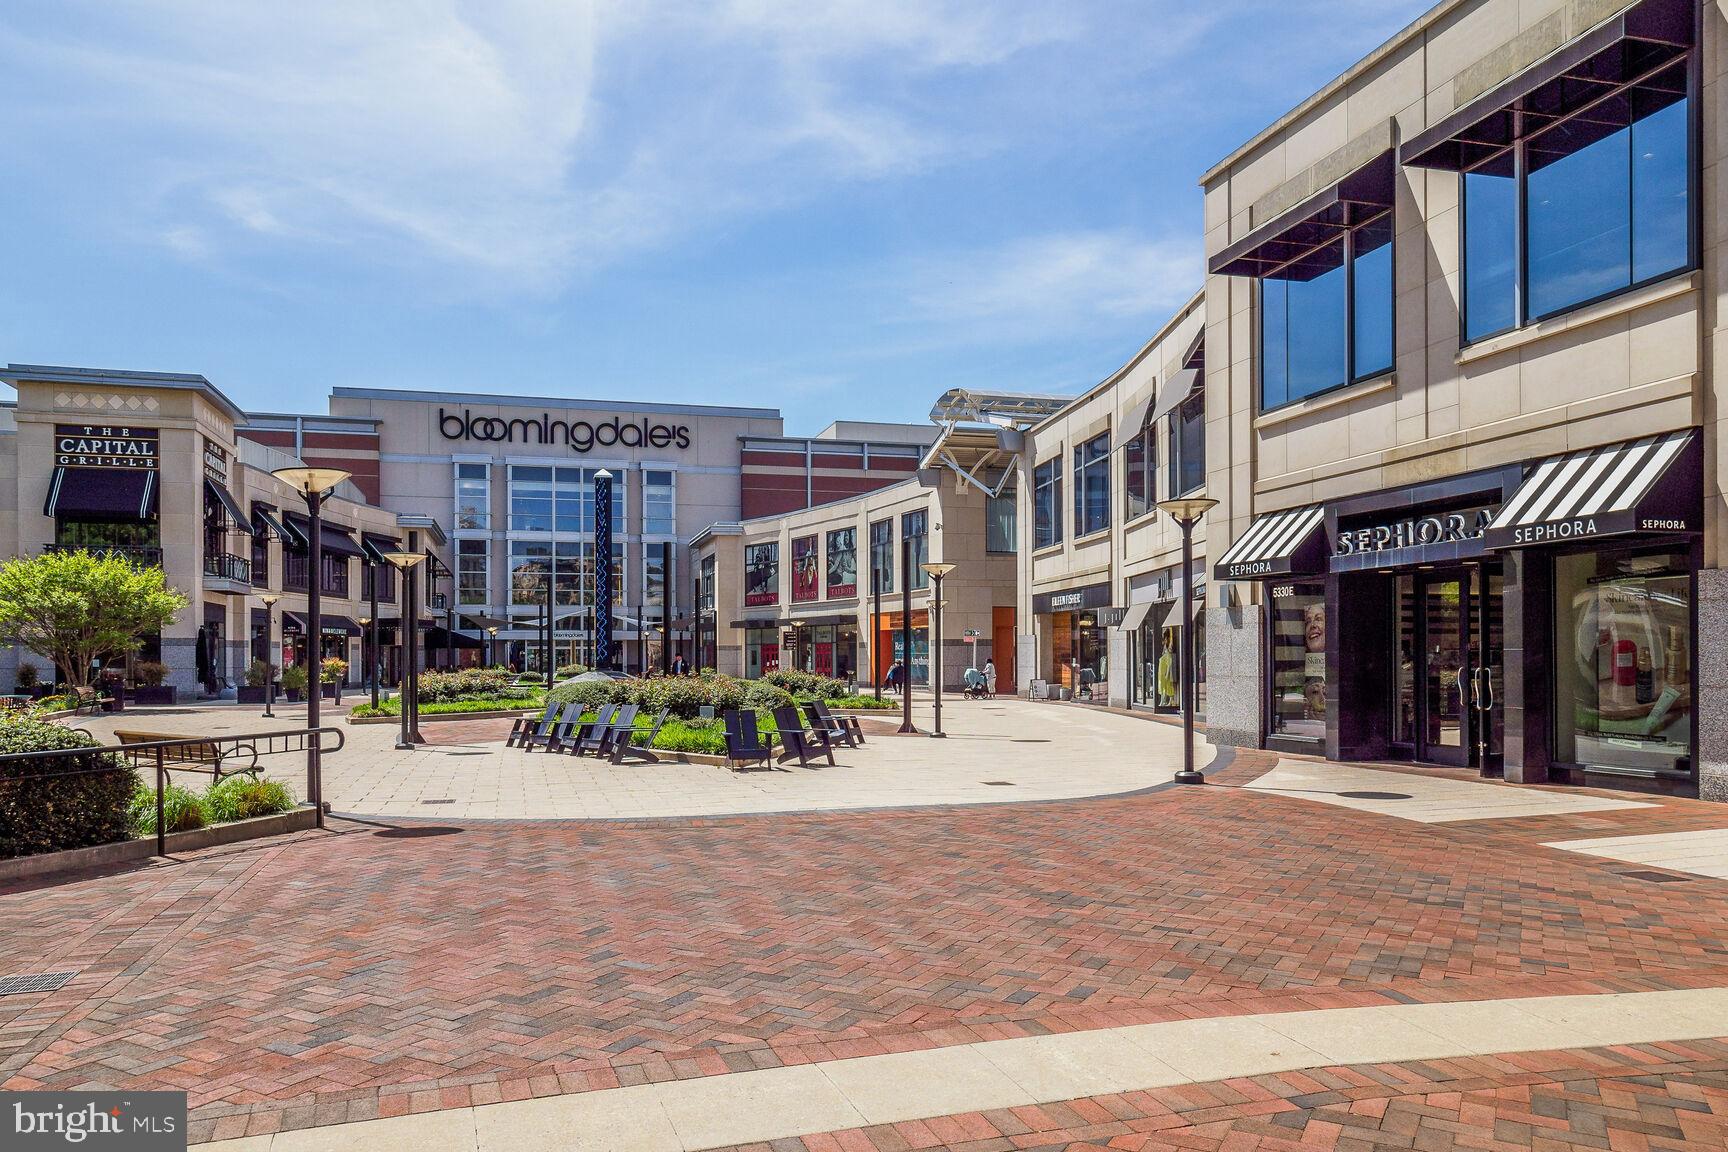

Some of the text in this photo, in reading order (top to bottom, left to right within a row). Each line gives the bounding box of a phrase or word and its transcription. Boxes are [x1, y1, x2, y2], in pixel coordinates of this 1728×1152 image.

[84, 427, 130, 437] THE
[60, 439, 154, 456] CAPITAL
[1515, 519, 1597, 543] SEPHORA
[1642, 519, 1686, 530] SEPHORA
[1337, 509, 1492, 556] SEPHORA
[1229, 561, 1272, 576] SEPHORA
[831, 587, 855, 595] TALBOTS
